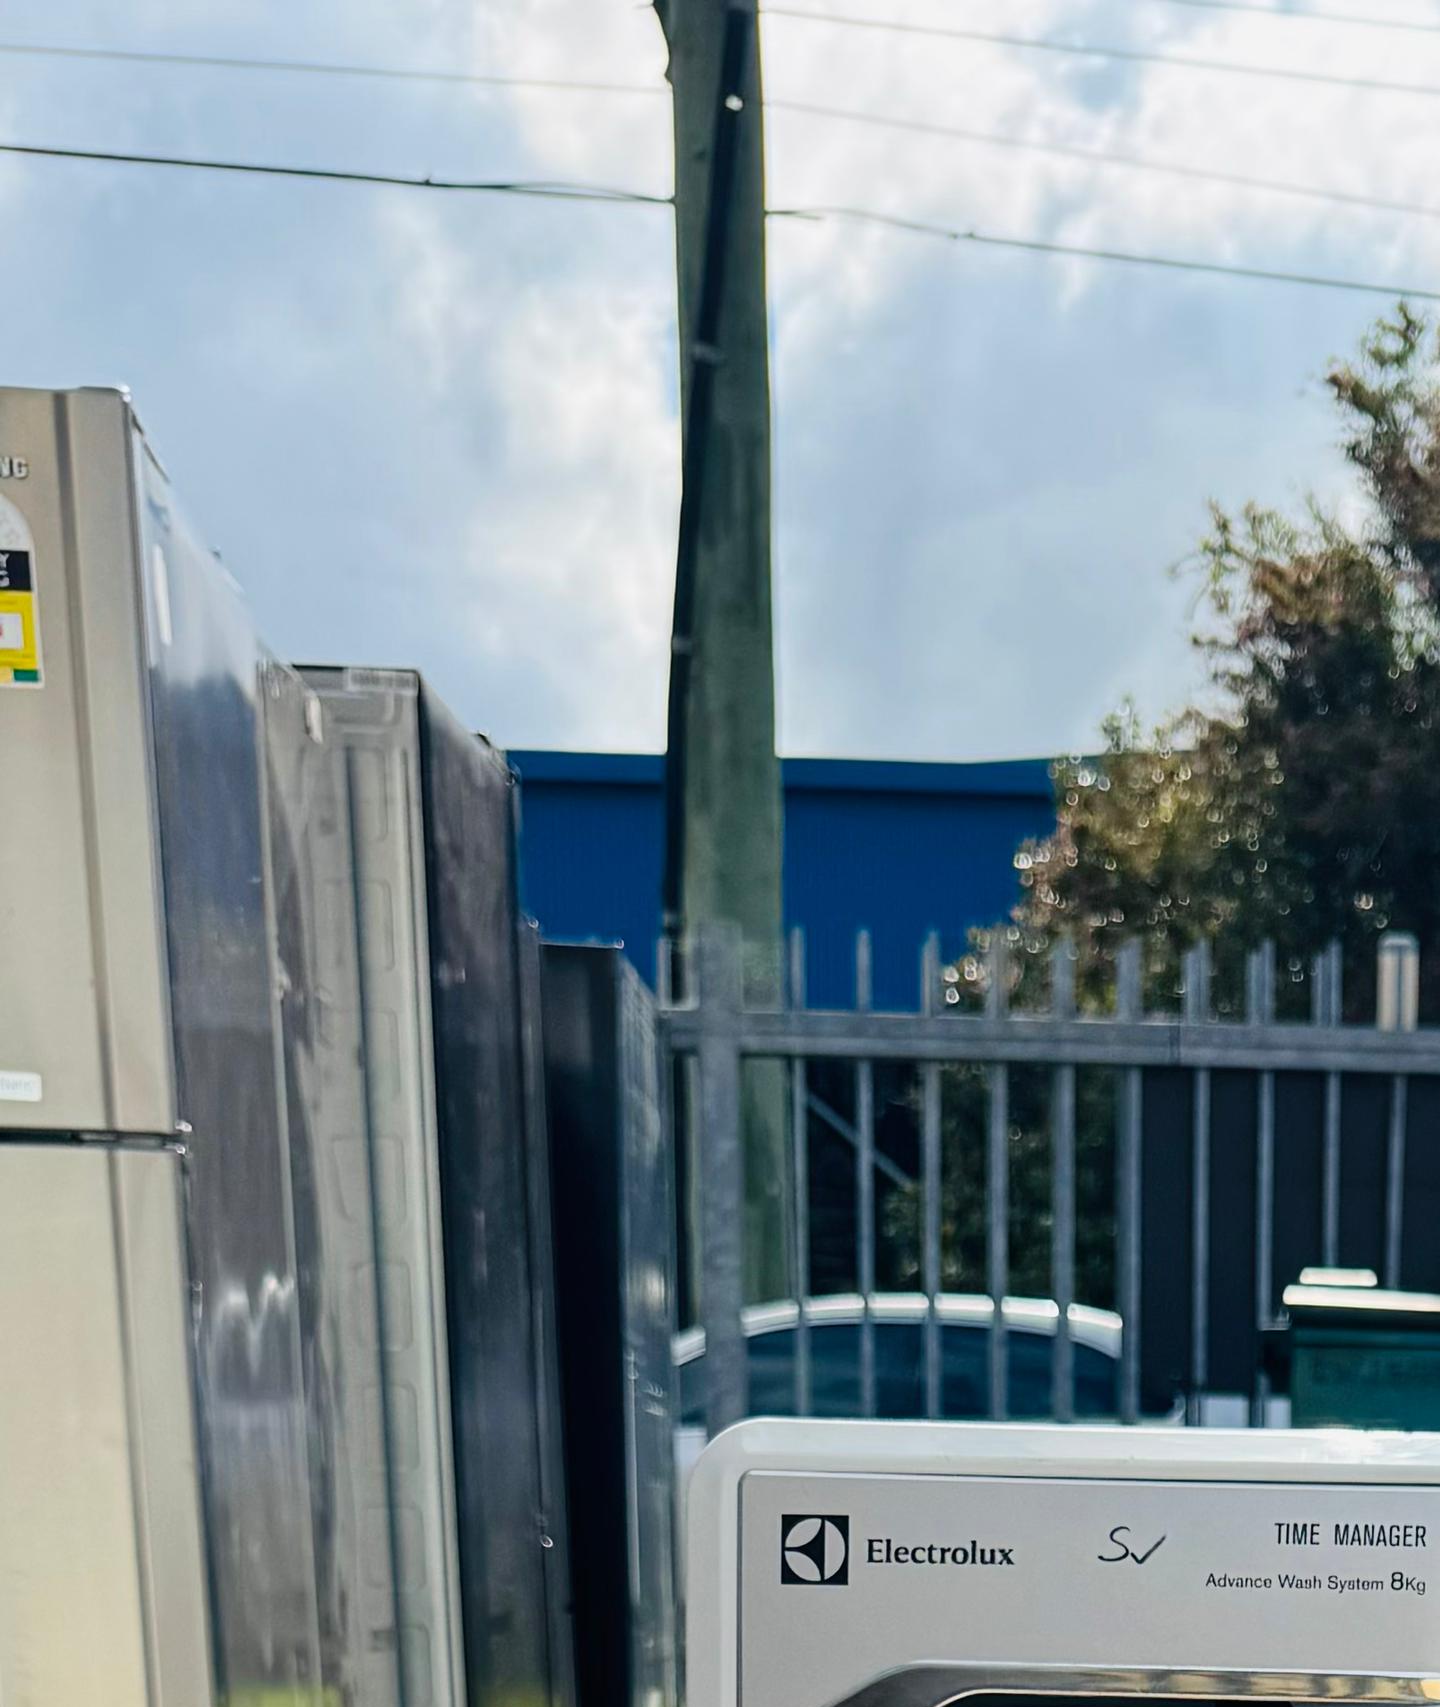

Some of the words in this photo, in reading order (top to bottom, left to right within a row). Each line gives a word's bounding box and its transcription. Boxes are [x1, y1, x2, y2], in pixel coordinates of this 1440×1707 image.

[1274, 1522, 1321, 1545] TIME
[1334, 1523, 1428, 1548] MANAGER
[866, 1538, 1015, 1567] Electrolux
[1206, 1573, 1273, 1589] Advance
[1278, 1574, 1323, 1591] Wash
[1327, 1575, 1385, 1596] System
